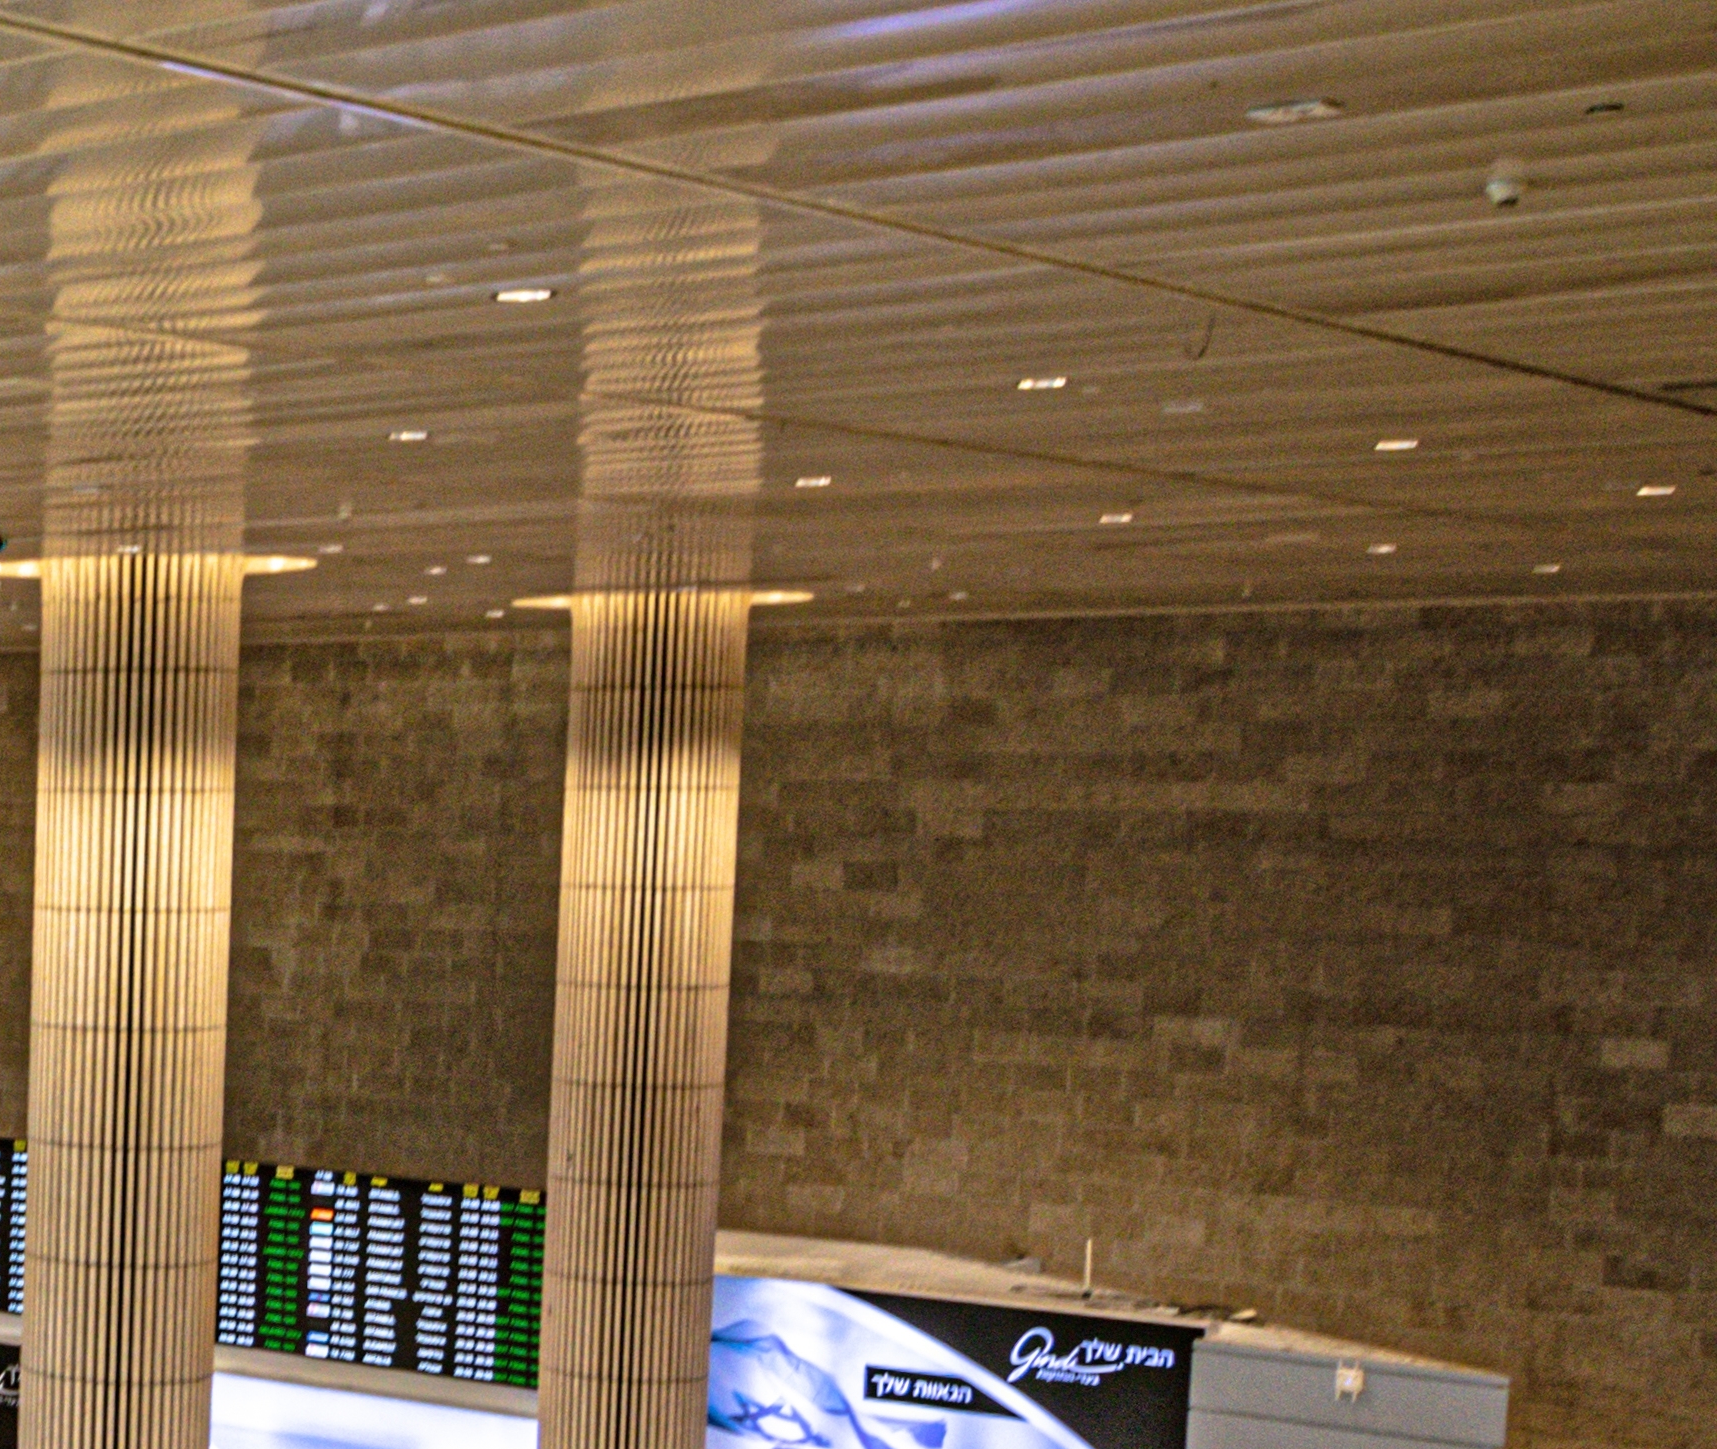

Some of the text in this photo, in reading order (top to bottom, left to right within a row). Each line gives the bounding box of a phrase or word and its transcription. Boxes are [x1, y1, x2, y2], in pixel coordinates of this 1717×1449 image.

[1080, 1337, 1176, 1369] הבית שלך
[871, 1371, 911, 1398] שלך
